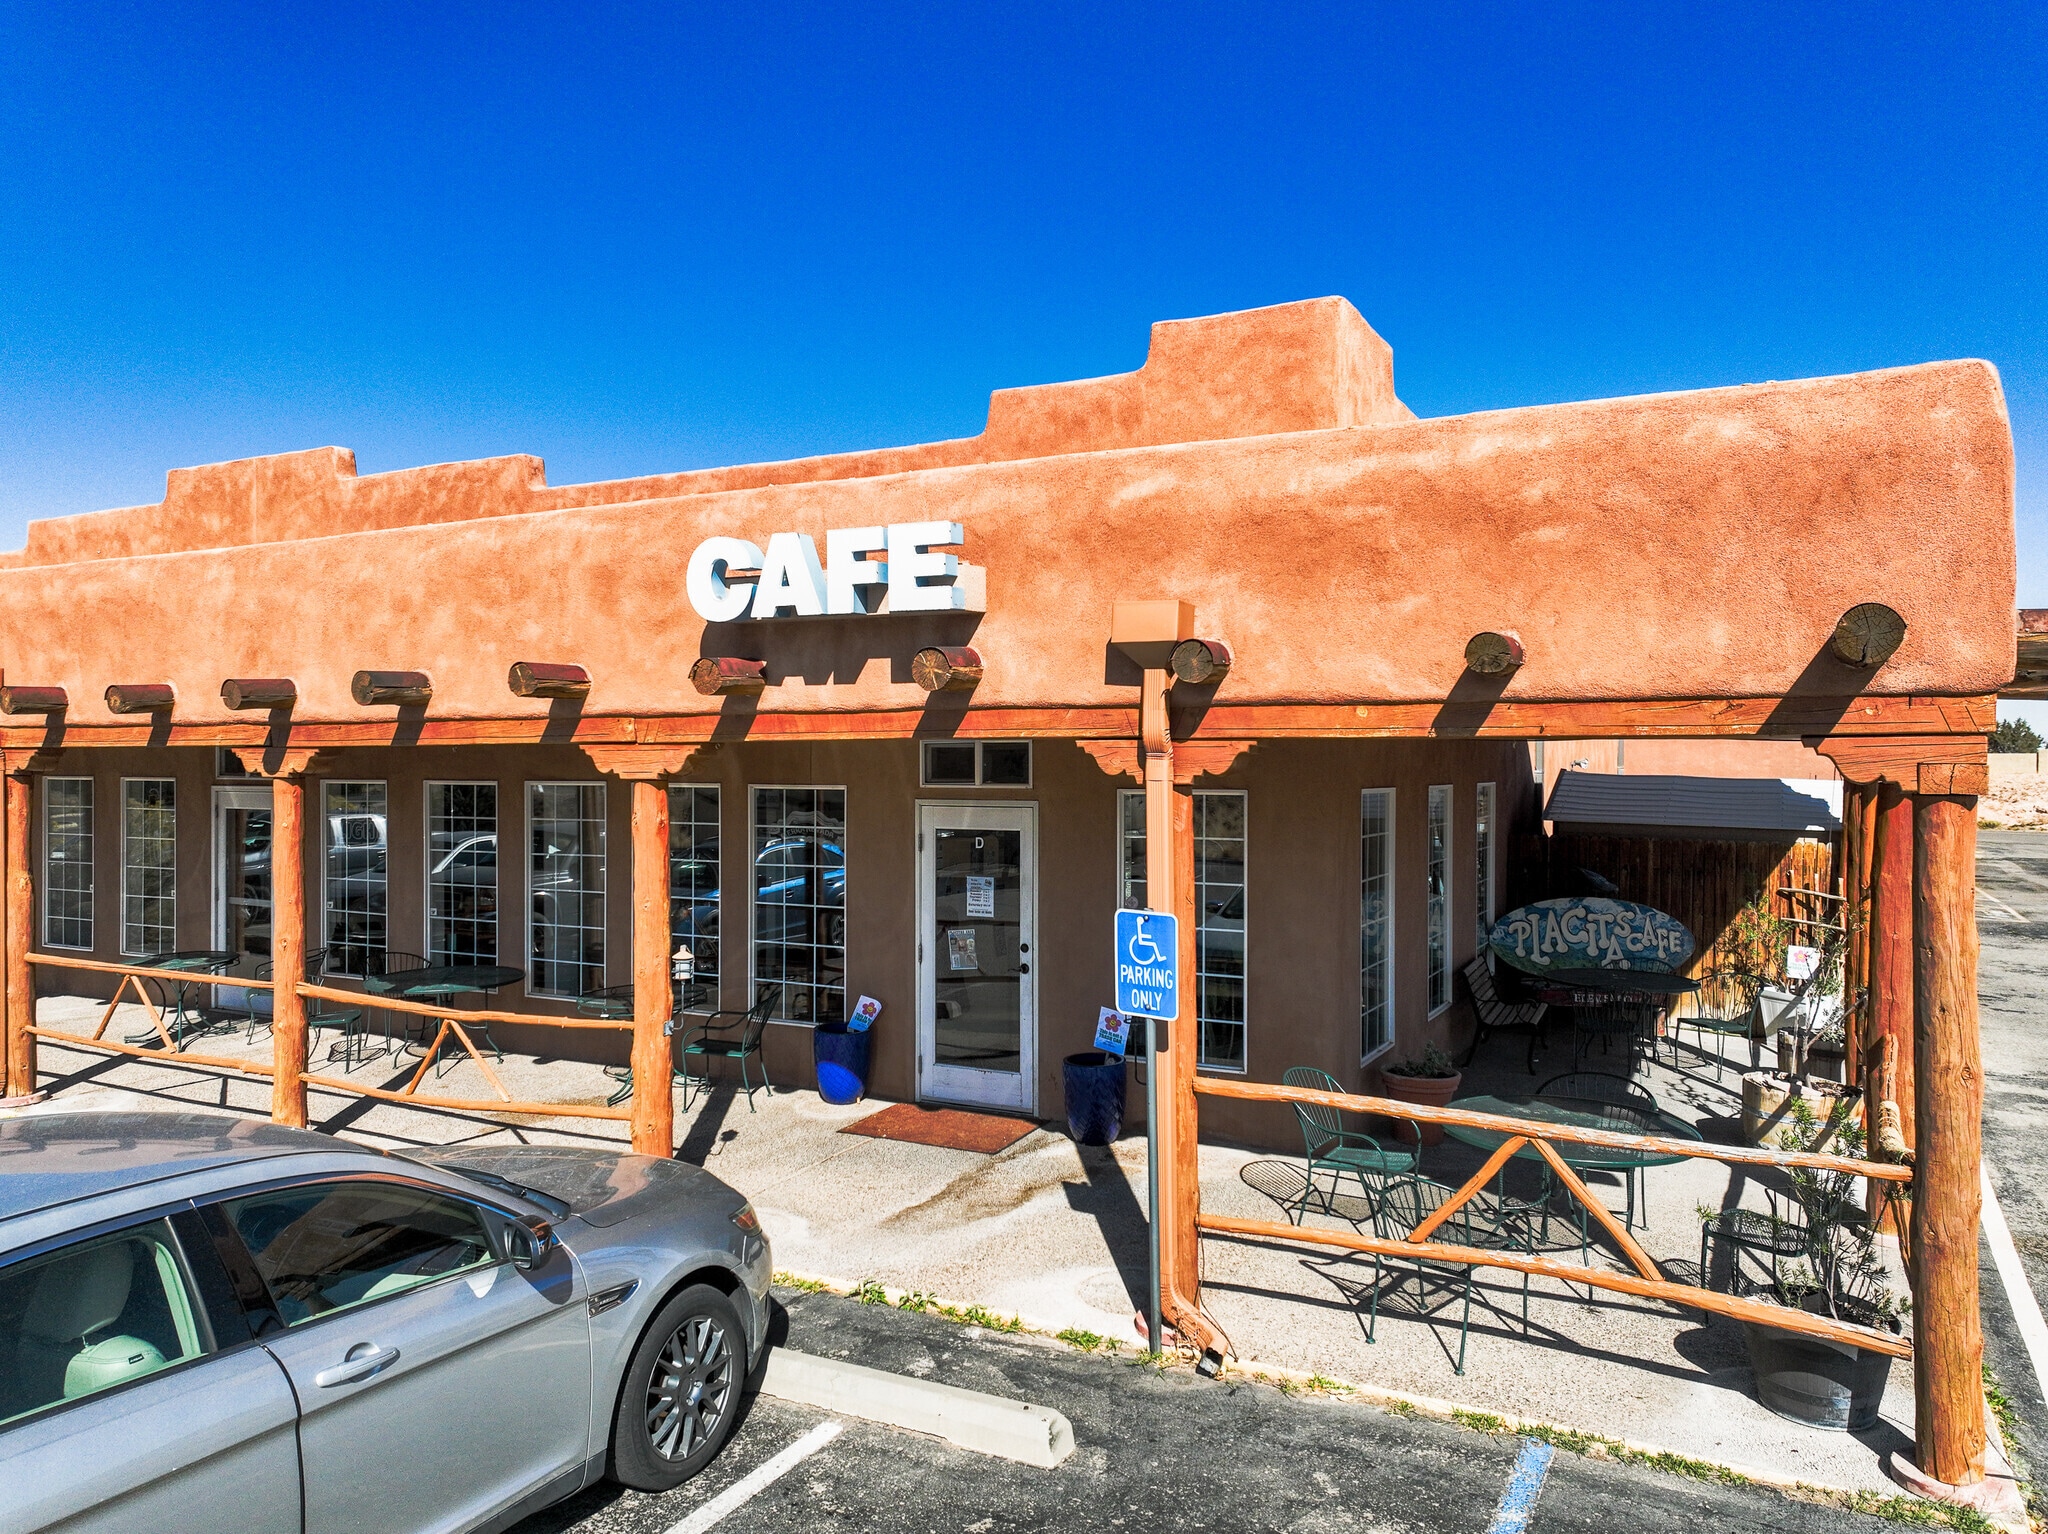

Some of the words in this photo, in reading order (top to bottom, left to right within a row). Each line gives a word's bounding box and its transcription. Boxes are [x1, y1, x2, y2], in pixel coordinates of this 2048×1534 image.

[686, 520, 963, 622] CAFE
[975, 836, 985, 849] D
[1625, 915, 1682, 959] CAFE
[1120, 964, 1174, 990] PARKING
[1131, 988, 1163, 1012] ONLY
